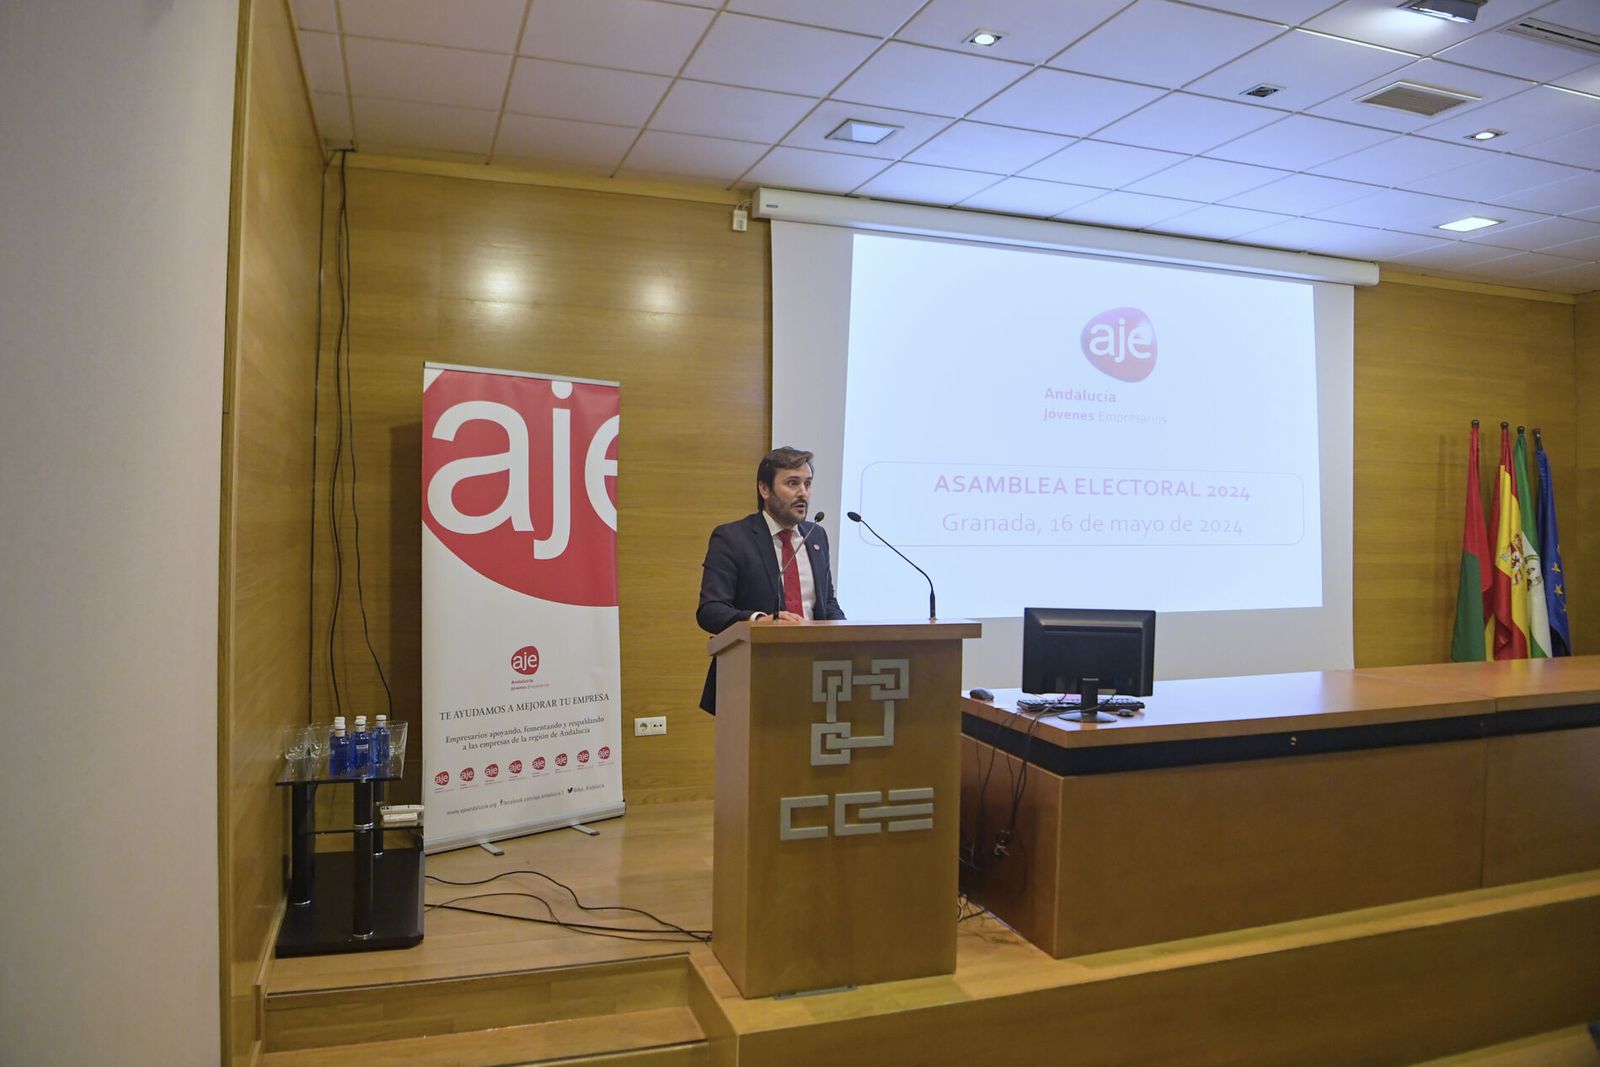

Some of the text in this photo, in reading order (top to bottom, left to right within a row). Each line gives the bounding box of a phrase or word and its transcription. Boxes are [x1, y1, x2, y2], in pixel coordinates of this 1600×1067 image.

[1089, 317, 1153, 363] aje
[1098, 410, 1168, 425] Empresarios
[933, 474, 1251, 502] ASAMBLEA ELECTORAL 2024
[942, 512, 1243, 537] Granada, 16 de mayo de 2024
[512, 651, 538, 671] aje
[439, 693, 610, 721] TE AYUDAMOS A MEJORAR TU EMPRESA
[445, 731, 488, 744] Empresarios
[489, 726, 522, 738] apoyando,
[523, 721, 562, 733] fomentando
[568, 715, 605, 728] respaldando
[468, 741, 479, 750] las
[479, 738, 511, 749] empresas
[511, 736, 520, 744] de
[521, 735, 527, 743] la
[550, 731, 558, 739] de
[435, 773, 449, 784] aje
[461, 770, 474, 780] aje
[485, 766, 498, 777] aje
[509, 762, 522, 772] aje
[533, 758, 545, 769] aje
[555, 755, 567, 766] aje
[577, 752, 589, 762] aje
